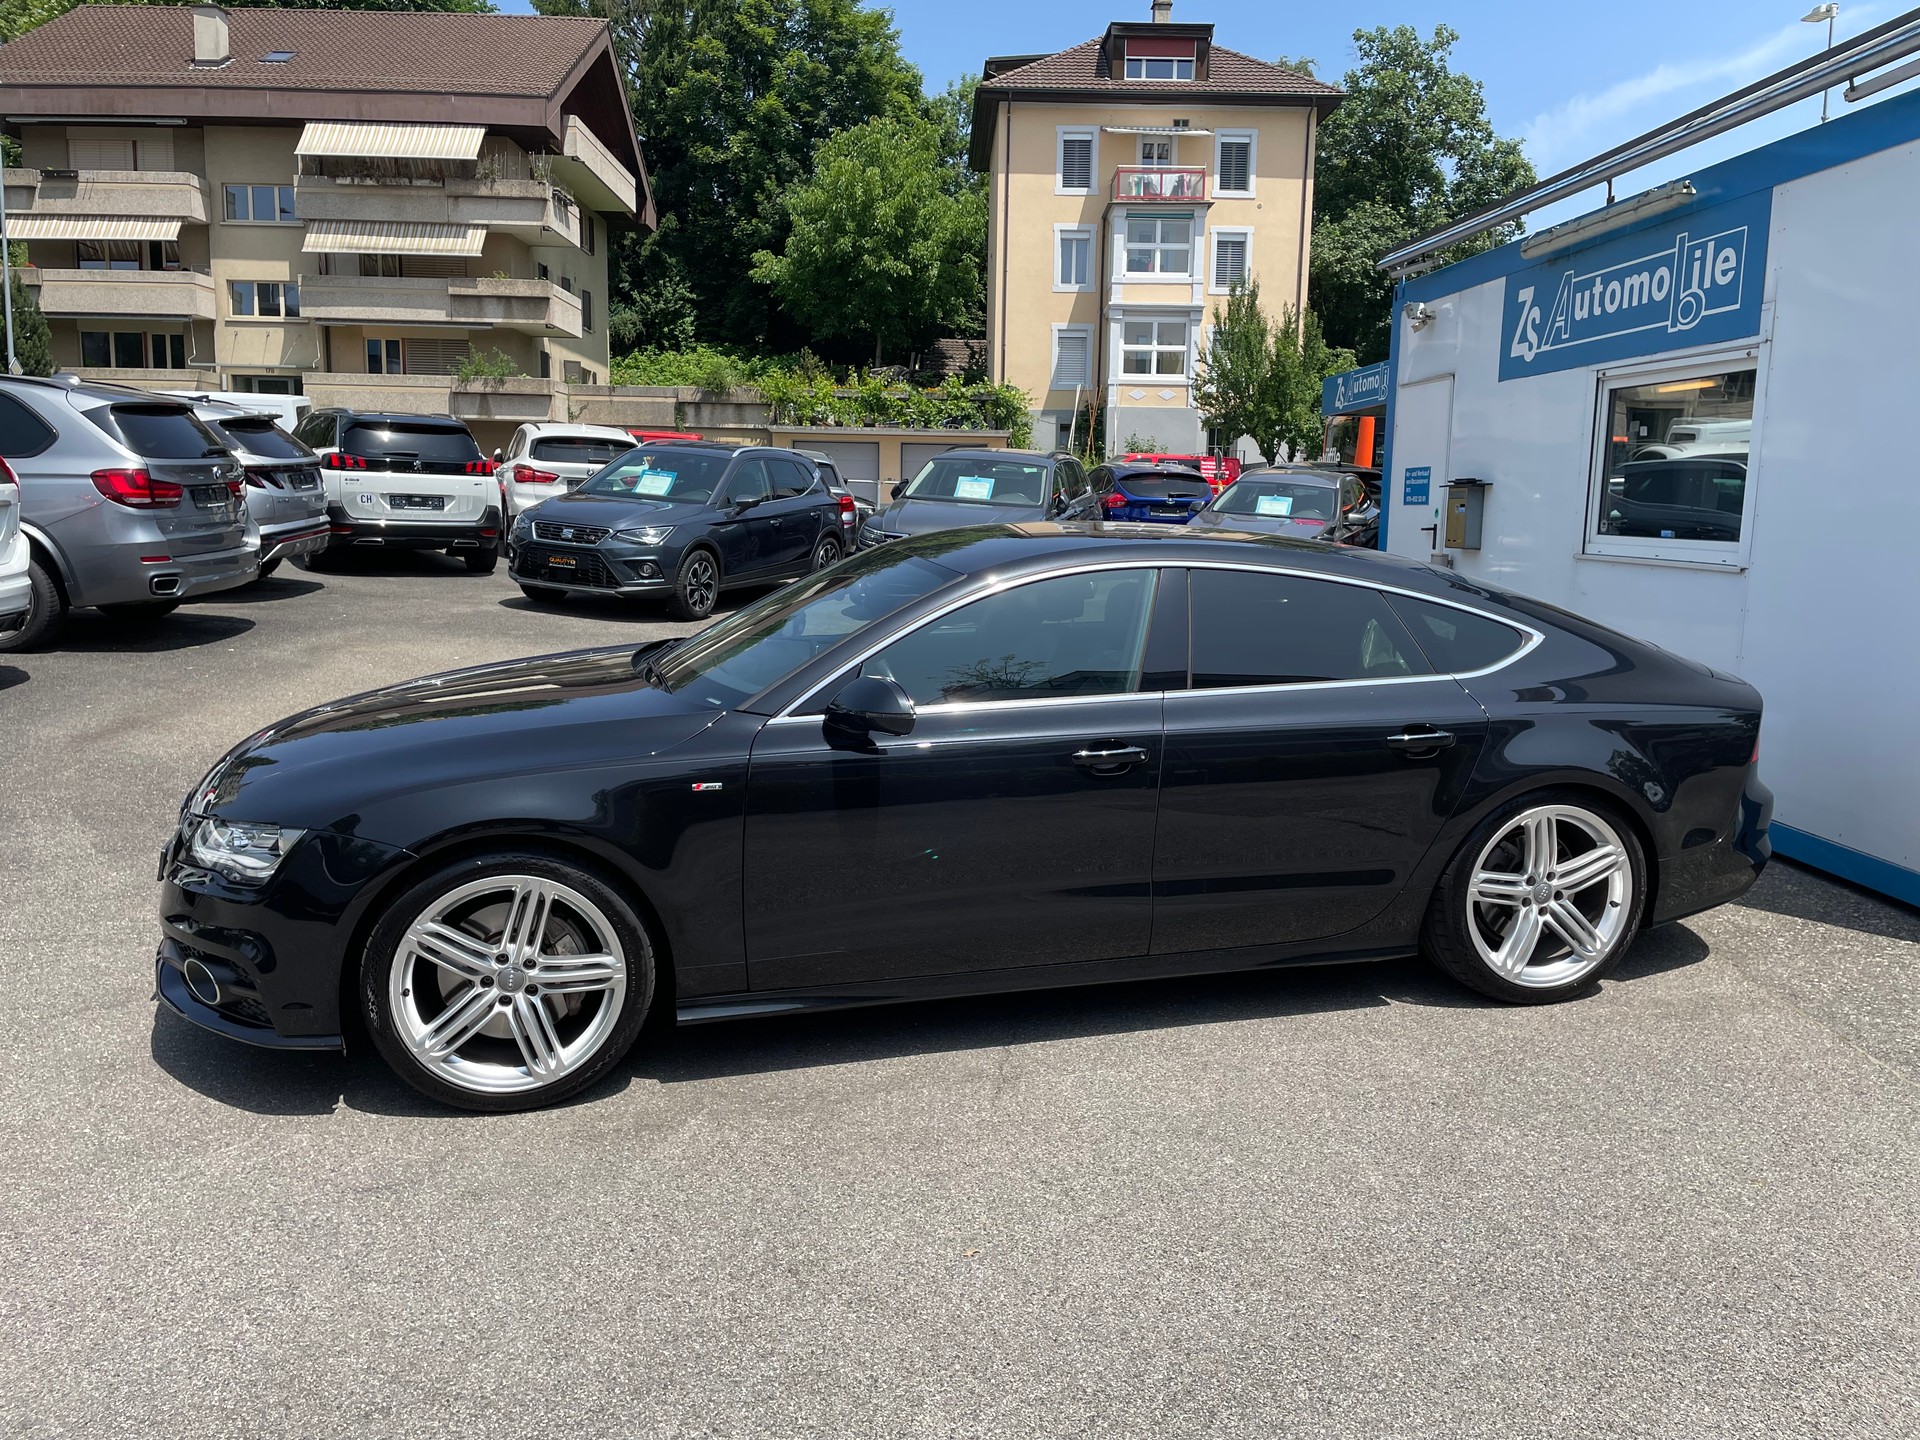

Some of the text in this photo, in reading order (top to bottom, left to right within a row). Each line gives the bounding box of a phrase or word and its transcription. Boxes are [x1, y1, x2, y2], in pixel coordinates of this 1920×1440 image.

[1511, 232, 1737, 362] Zs Automobile
[360, 494, 373, 504] CH
